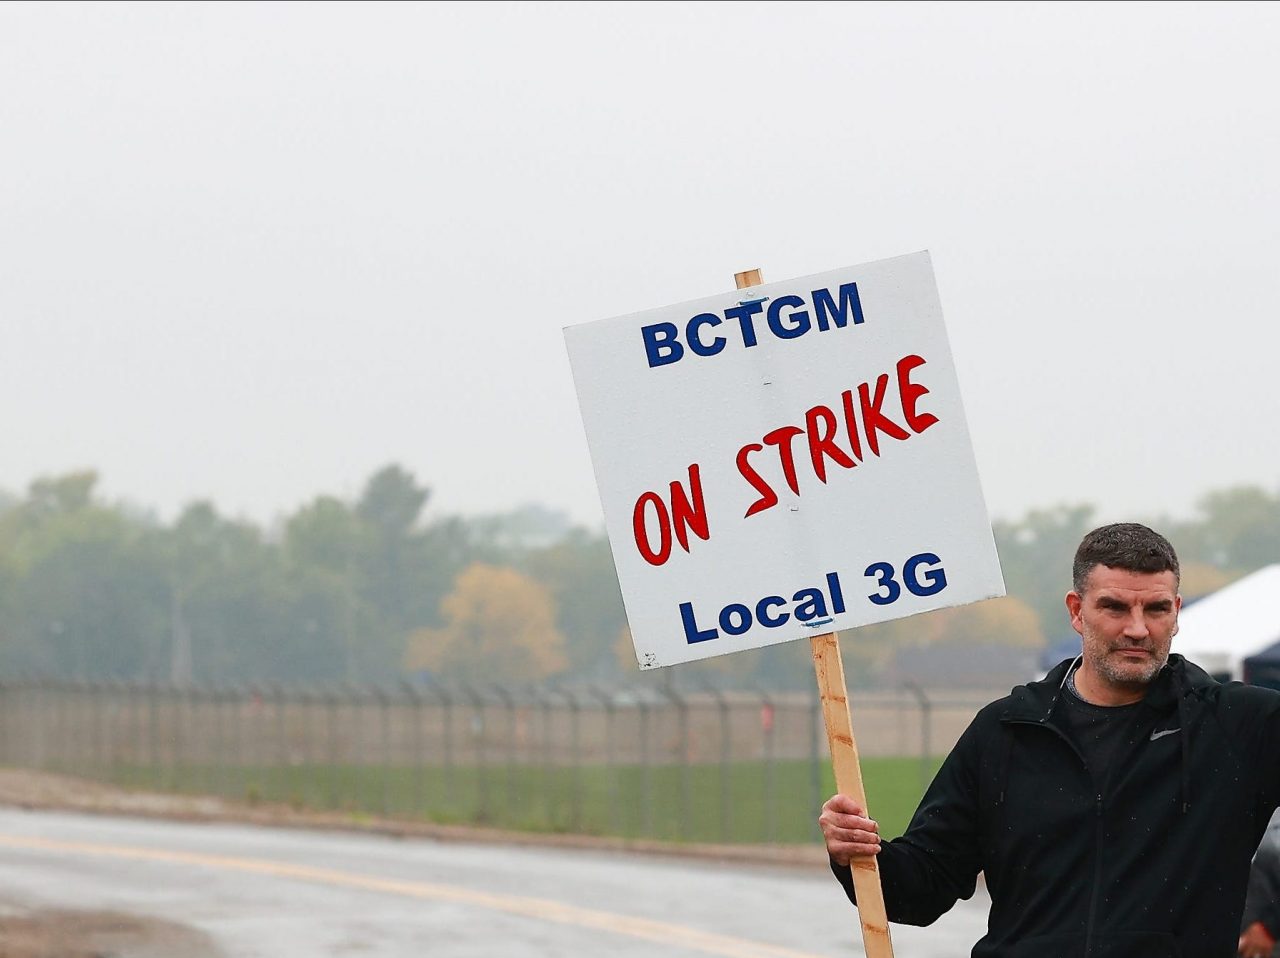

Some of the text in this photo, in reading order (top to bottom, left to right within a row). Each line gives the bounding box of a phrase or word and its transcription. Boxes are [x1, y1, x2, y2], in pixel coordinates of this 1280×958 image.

[641, 282, 864, 369] BCTGM
[632, 353, 940, 567] ON STRIKE
[679, 552, 947, 644] Local 3G
